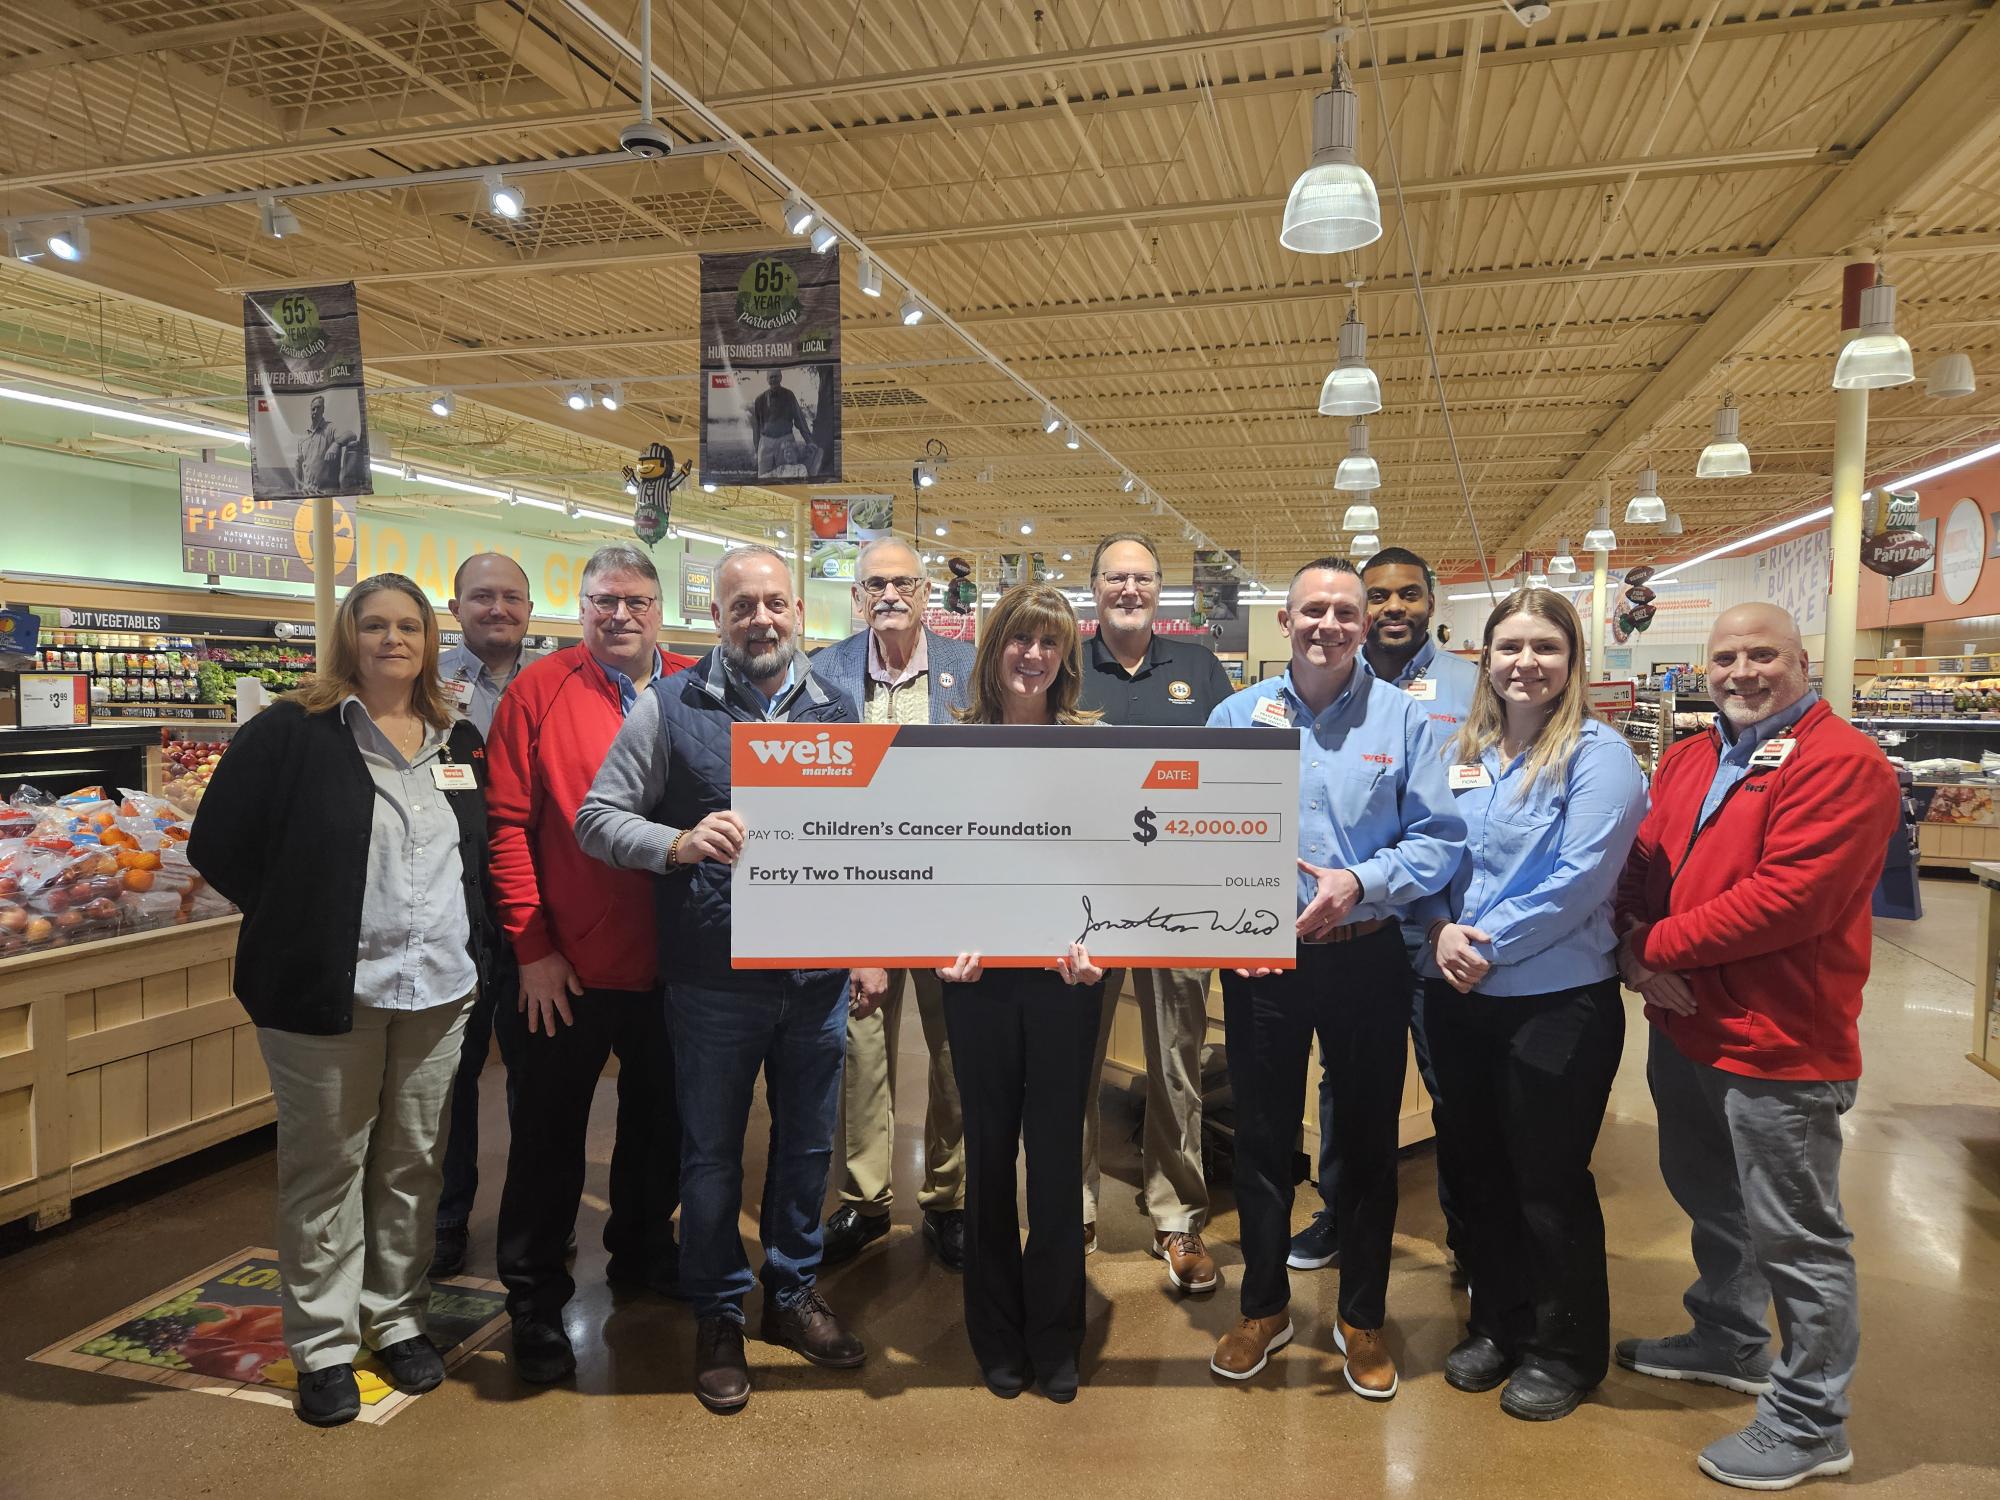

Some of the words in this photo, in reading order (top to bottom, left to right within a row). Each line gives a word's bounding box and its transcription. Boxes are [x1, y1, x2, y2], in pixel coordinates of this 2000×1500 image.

[754, 295, 781, 310] YEAR
[738, 307, 798, 329] partnership
[279, 338, 326, 360] partnership
[708, 344, 763, 359] HUNTSINGER
[765, 341, 793, 358] FARM
[802, 340, 826, 352] LOCAL
[287, 369, 325, 384] PRODUCE
[330, 364, 350, 378] LOCAL
[218, 536, 243, 546] FRUIT
[255, 540, 289, 550] VEGGIES
[224, 530, 265, 542] NATURALLY
[268, 535, 288, 543] TASTY
[1874, 547, 1906, 563] Party
[71, 611, 92, 626] CUT
[95, 612, 161, 630] VEGETABLES
[748, 732, 853, 765] weis
[1360, 752, 1394, 765] weis
[802, 766, 853, 776] markets
[1157, 769, 1192, 780] DATE:
[748, 830, 769, 840] PAY
[774, 830, 795, 840] TO:
[802, 821, 894, 836] Children's
[898, 822, 963, 836] Cancer
[967, 821, 1072, 837] Foundation
[1132, 806, 1158, 846] $
[1164, 819, 1268, 837] 42,000.00
[749, 866, 799, 884] Forty
[803, 866, 839, 881] Two
[843, 866, 934, 881] Thousand
[1225, 876, 1281, 887] DOLLARS
